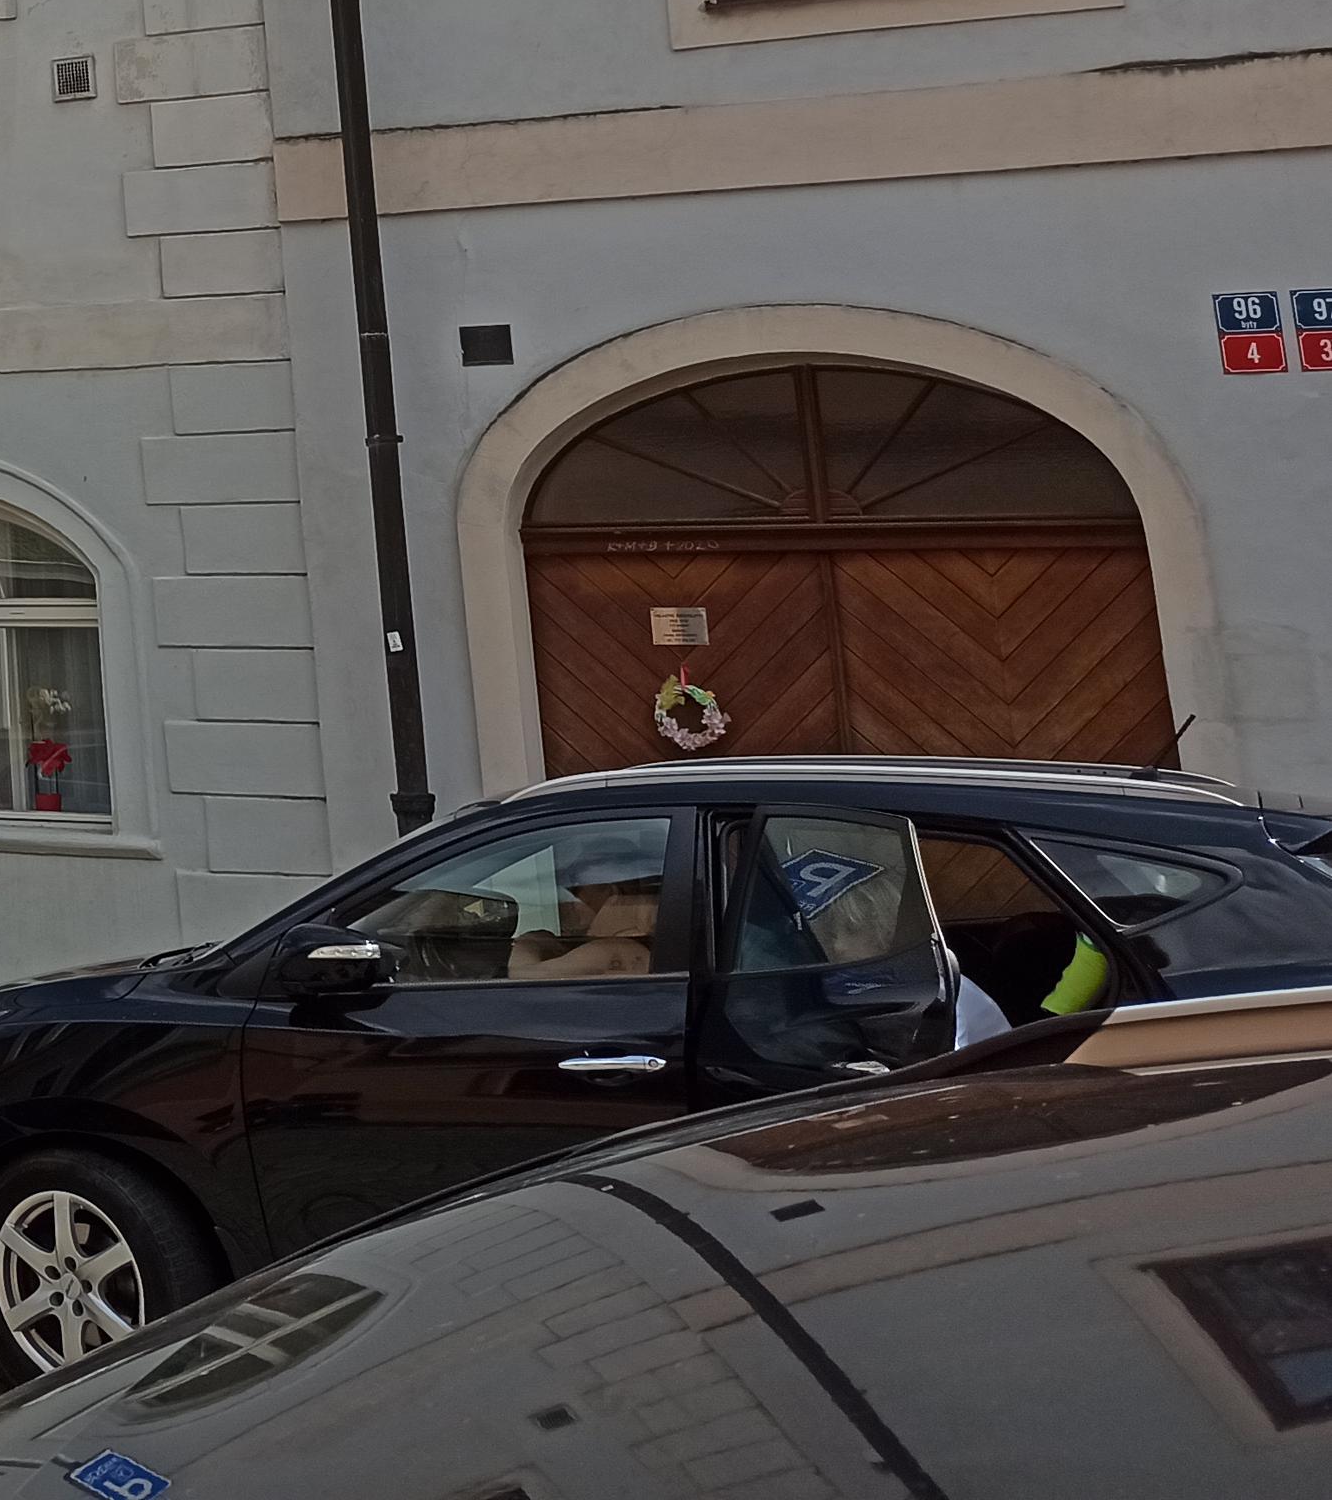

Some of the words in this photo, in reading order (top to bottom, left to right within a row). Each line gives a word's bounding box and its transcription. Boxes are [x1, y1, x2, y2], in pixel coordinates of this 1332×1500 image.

[1232, 297, 1262, 320] 96
[1241, 321, 1257, 330] byty
[1247, 342, 1261, 364] 4
[1319, 339, 1332, 361] 3
